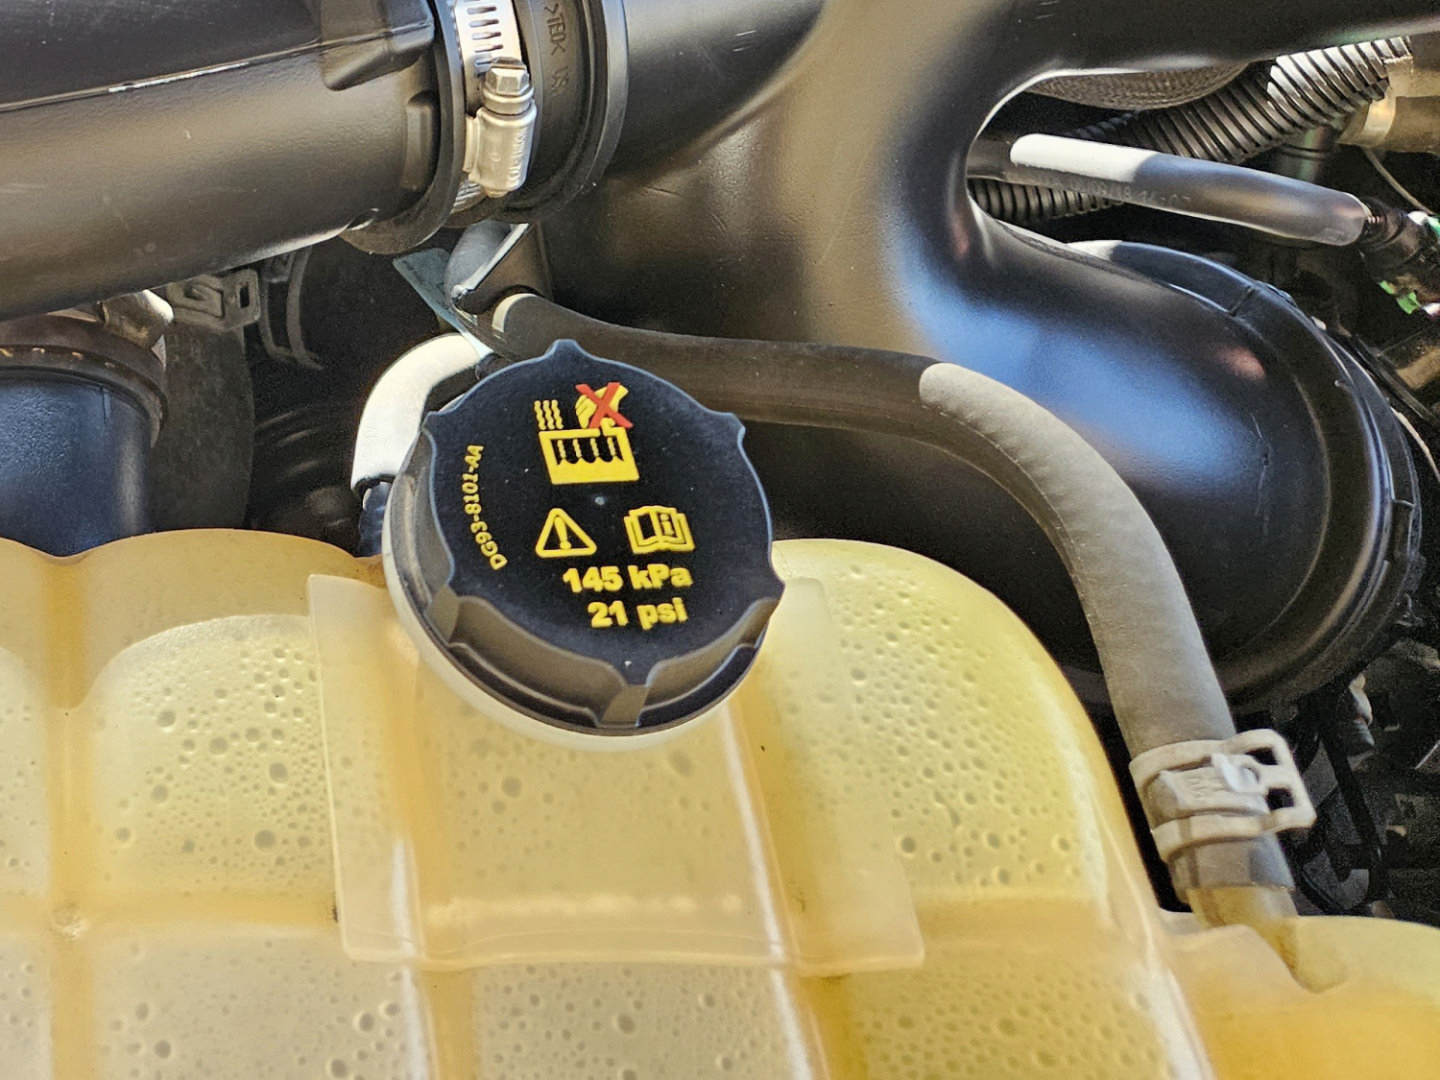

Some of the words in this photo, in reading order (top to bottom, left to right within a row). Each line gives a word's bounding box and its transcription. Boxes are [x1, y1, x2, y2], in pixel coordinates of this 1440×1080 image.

[462, 445, 507, 570] DG93-8101-AA
[563, 566, 623, 593] 145
[628, 564, 693, 589] kPa
[588, 601, 628, 627] 21
[637, 597, 688, 630] psi
